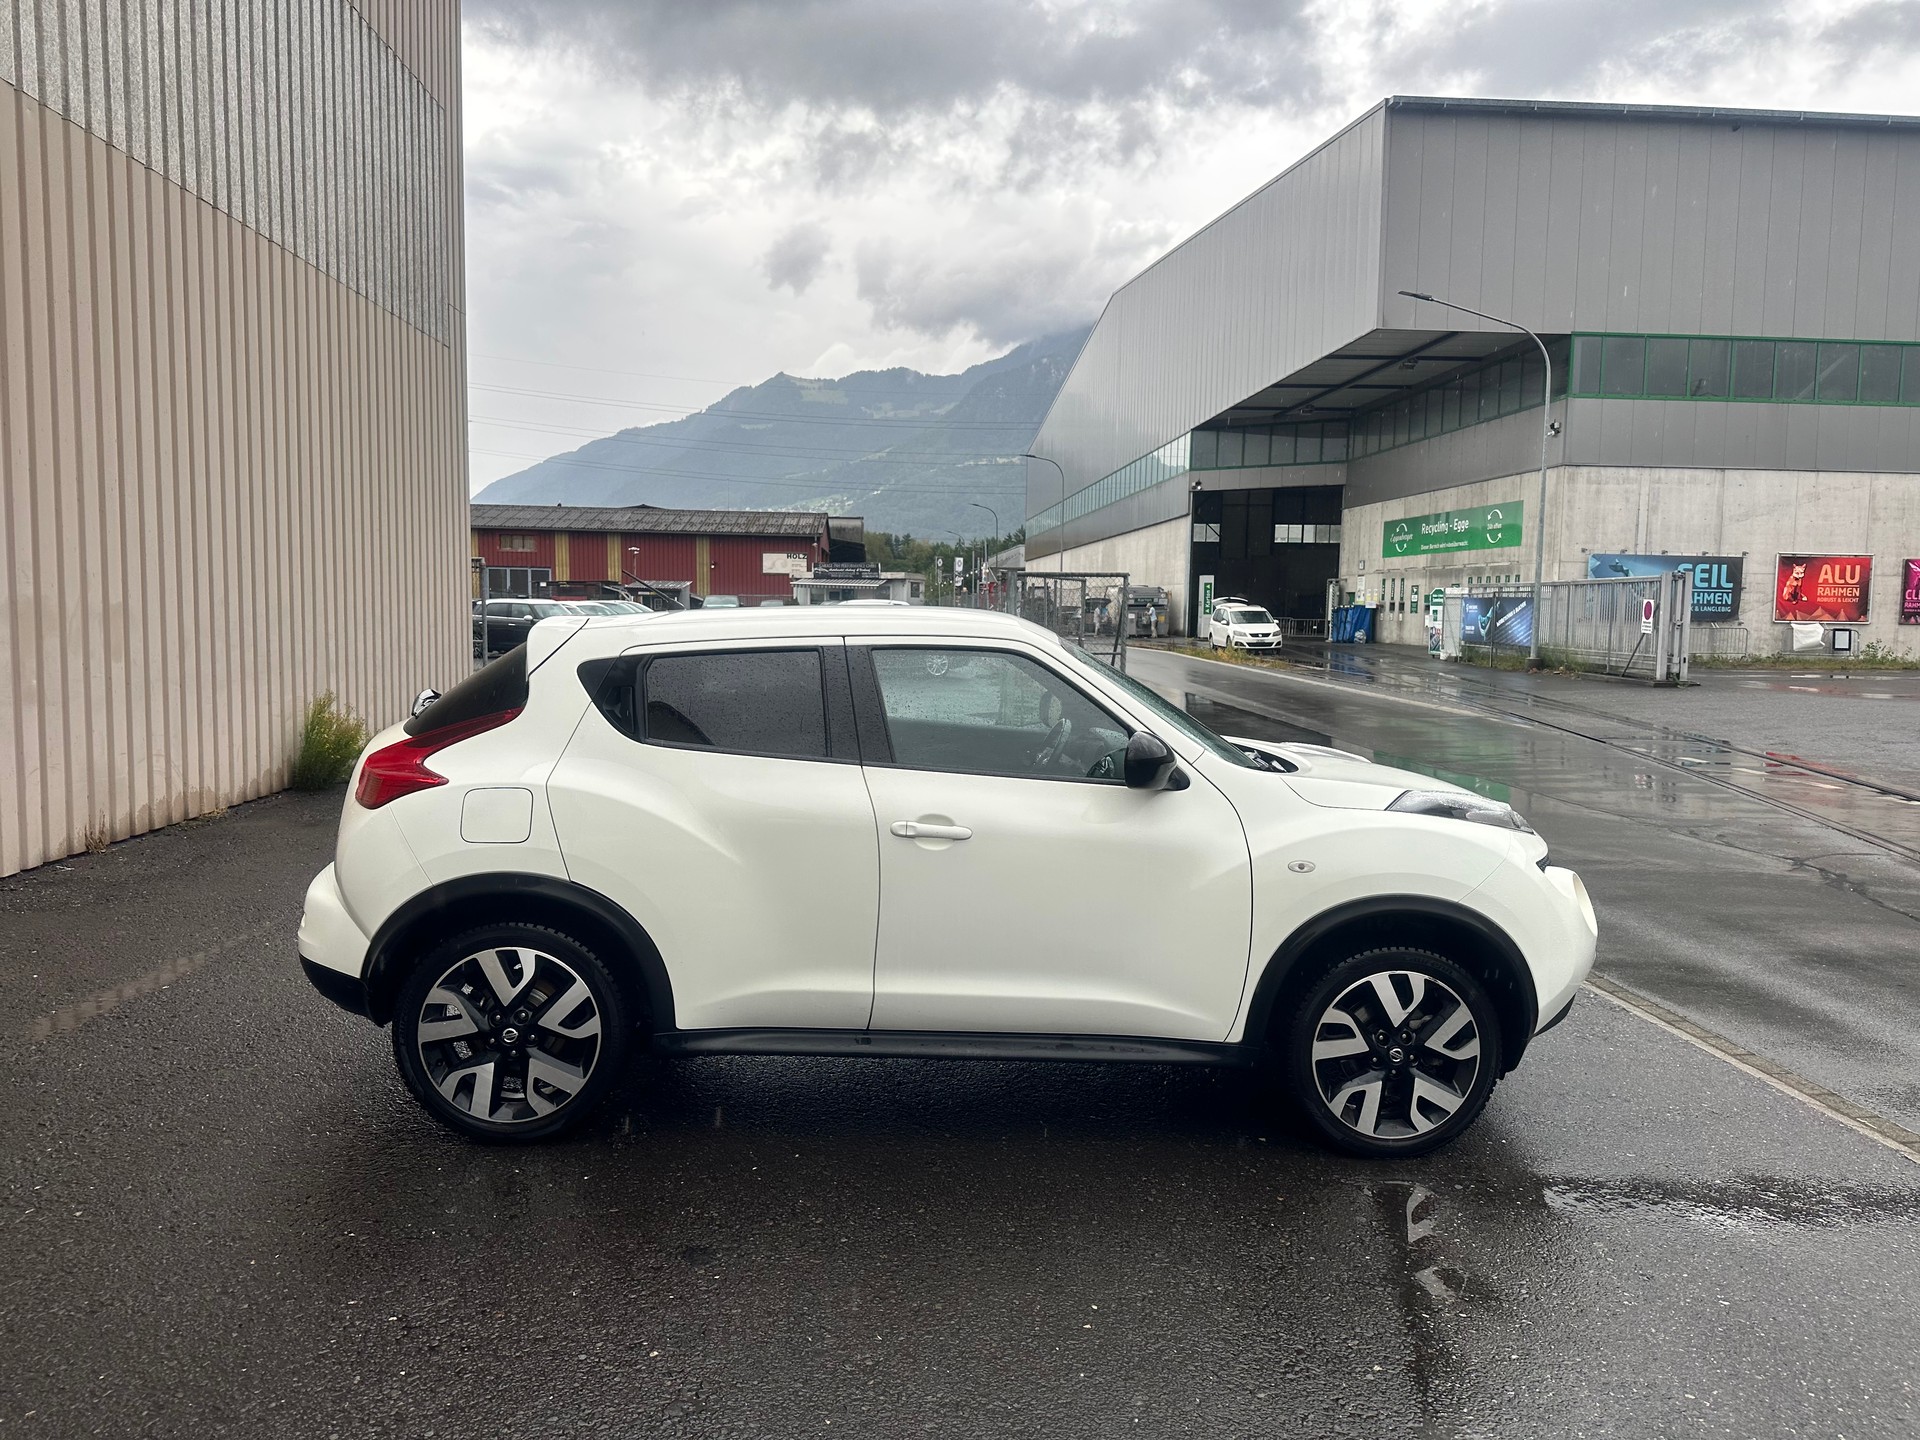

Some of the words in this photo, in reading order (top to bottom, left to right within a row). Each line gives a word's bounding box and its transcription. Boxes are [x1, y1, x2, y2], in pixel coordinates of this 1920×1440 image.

[1421, 521, 1448, 535] Recycling
[1453, 518, 1469, 533] Egge
[1818, 564, 1861, 584] ALU
[1817, 587, 1860, 597] RAHMEN
